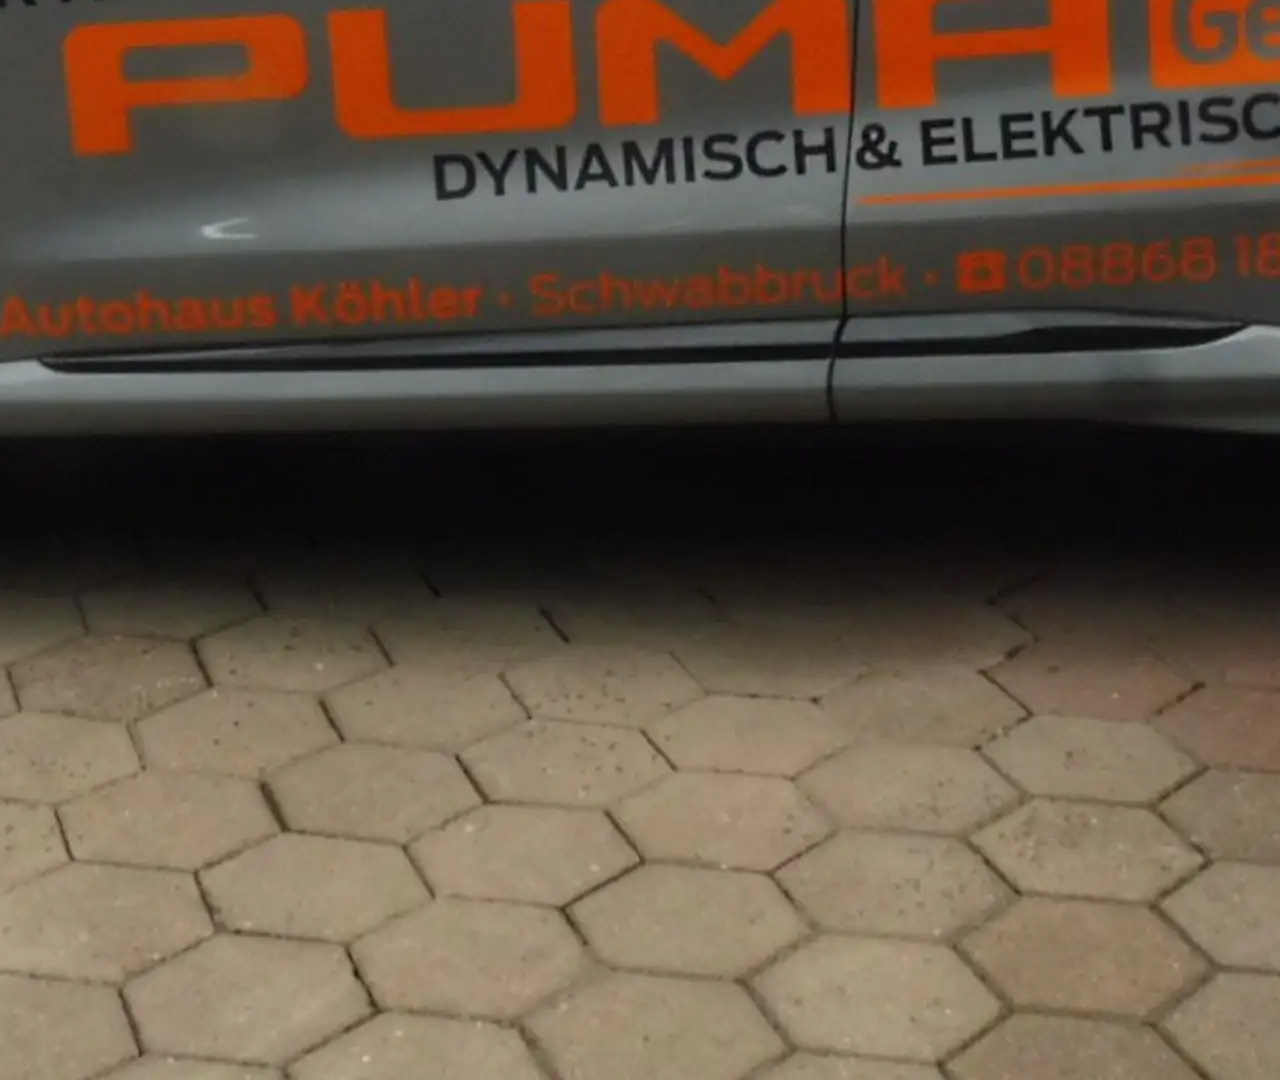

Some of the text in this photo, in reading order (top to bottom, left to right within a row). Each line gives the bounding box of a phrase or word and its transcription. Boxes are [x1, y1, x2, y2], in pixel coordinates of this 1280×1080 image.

[433, 127, 838, 201] DYNAMISCH
[855, 123, 902, 170] &
[290, 275, 484, 327] Köhler
[529, 255, 906, 316] Schwabbruck
[1018, 236, 1217, 290] 08868
